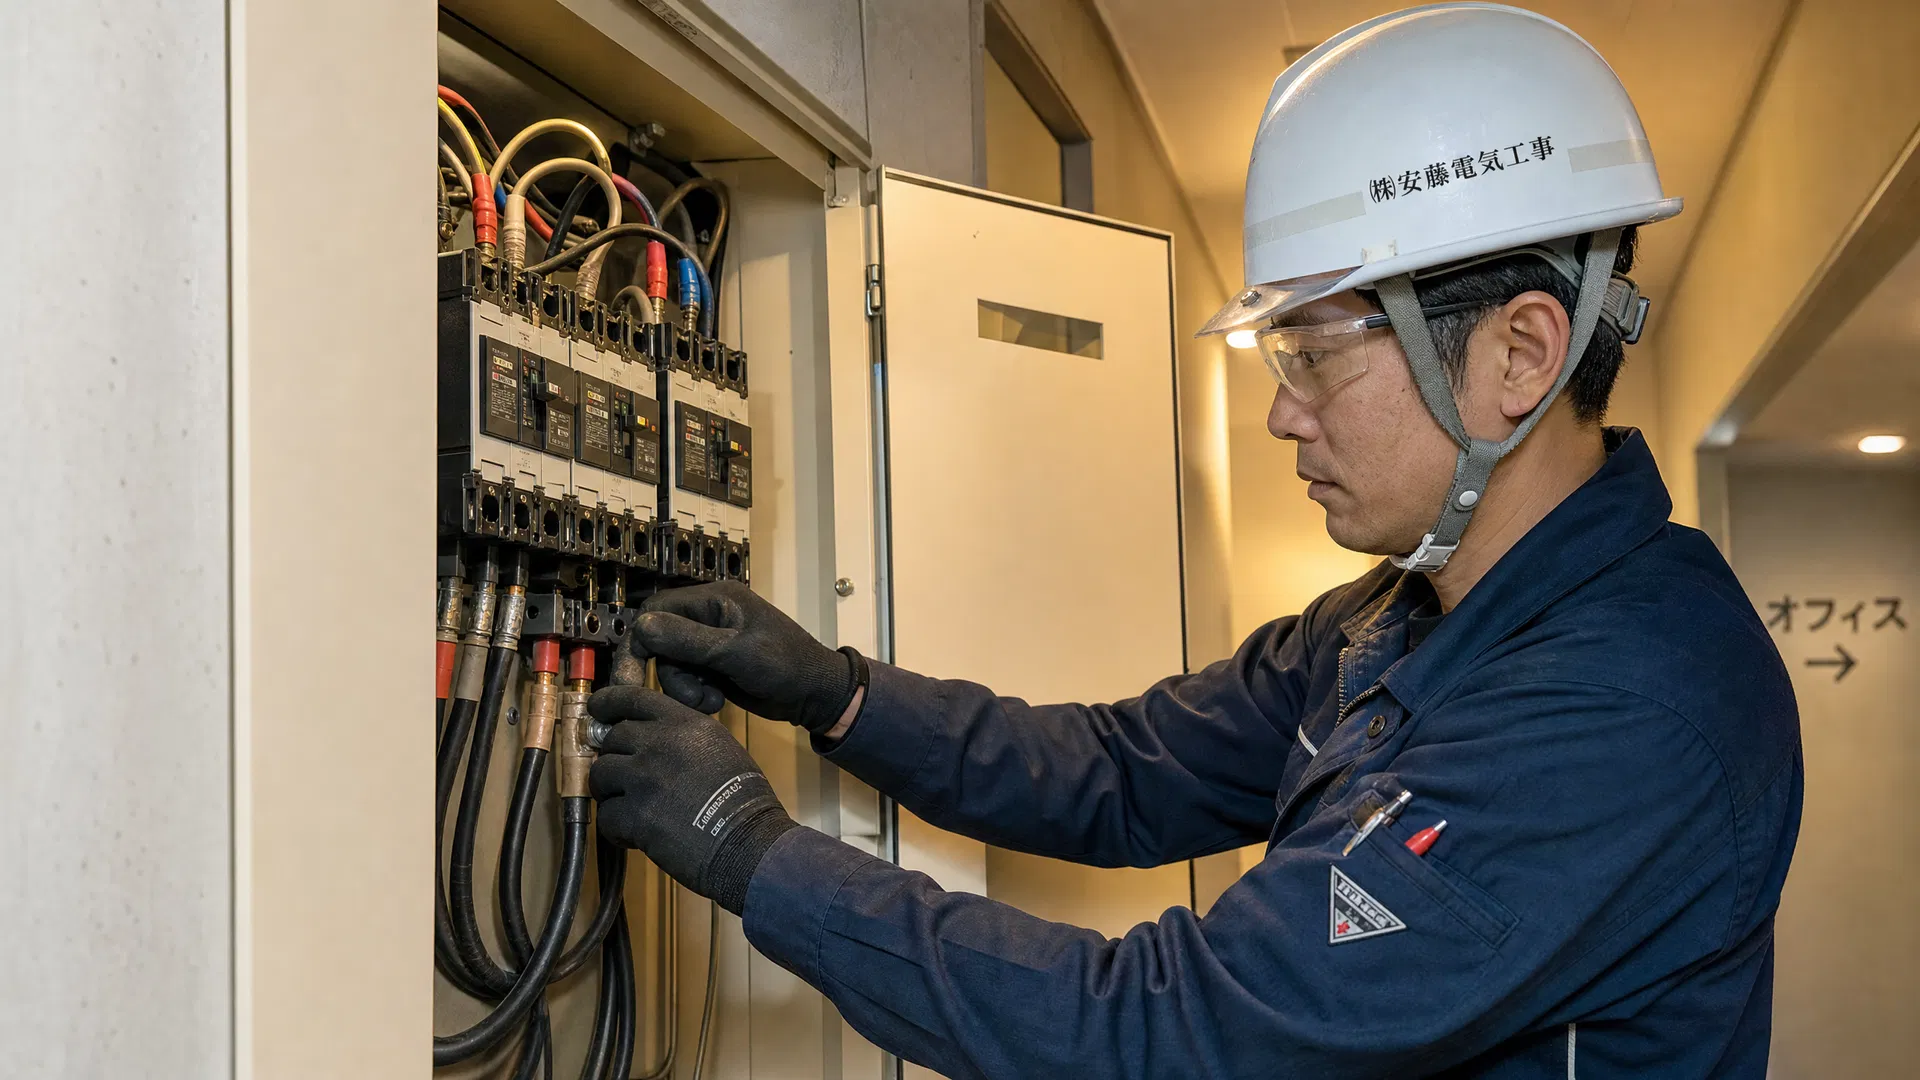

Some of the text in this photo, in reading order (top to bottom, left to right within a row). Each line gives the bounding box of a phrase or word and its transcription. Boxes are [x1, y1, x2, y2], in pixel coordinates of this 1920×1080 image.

[1369, 135, 1555, 203] (株)安藤電気工事
[1767, 594, 1907, 633] オフィス
